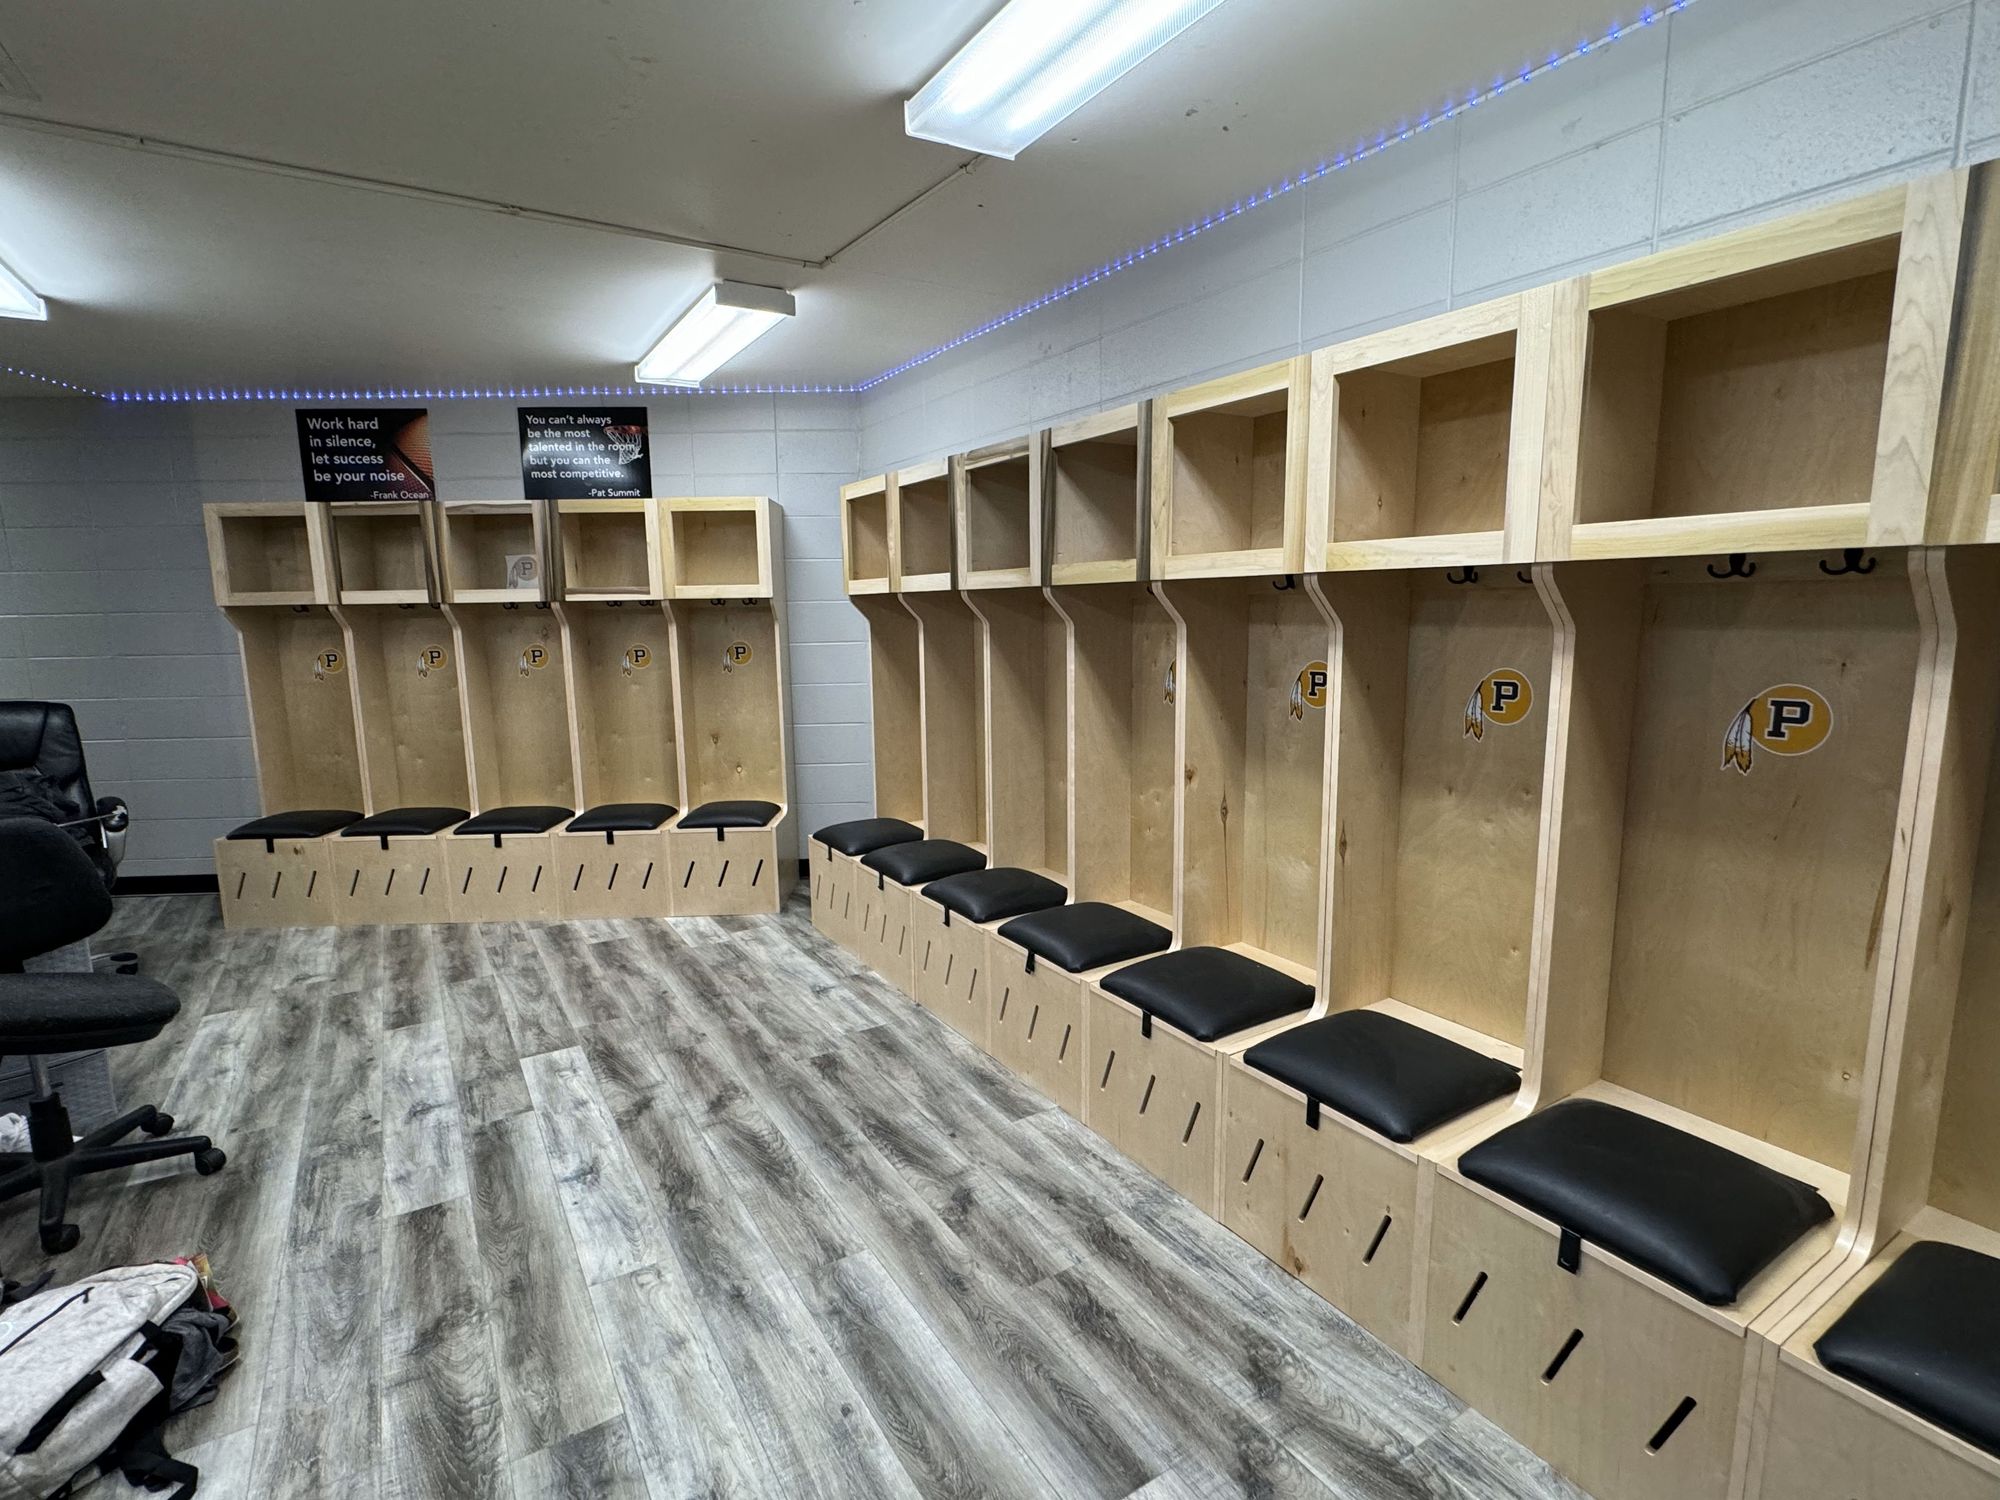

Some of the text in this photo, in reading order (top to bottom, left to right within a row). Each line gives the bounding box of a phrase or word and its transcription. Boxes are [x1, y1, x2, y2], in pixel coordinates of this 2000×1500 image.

[306, 416, 379, 430] Work hard
[525, 414, 612, 426] You can't always
[527, 428, 590, 438] be the most
[308, 435, 376, 448] in silence,
[528, 442, 572, 452] talented
[574, 442, 585, 452] in
[587, 442, 605, 451] the
[311, 452, 384, 464] let success
[529, 455, 611, 468] but you can the
[314, 469, 405, 485] be your noise
[530, 468, 624, 480] most competitive.
[370, 490, 429, 500] -Frank Ocean
[588, 488, 641, 497] -Pat Summit
[520, 561, 533, 576] P
[428, 650, 441, 665] P
[530, 649, 543, 663] P
[633, 649, 646, 663] P
[734, 646, 747, 660] P
[325, 653, 338, 668] P
[1308, 671, 1328, 697] P
[1492, 680, 1519, 712] P
[1767, 700, 1811, 738] P
